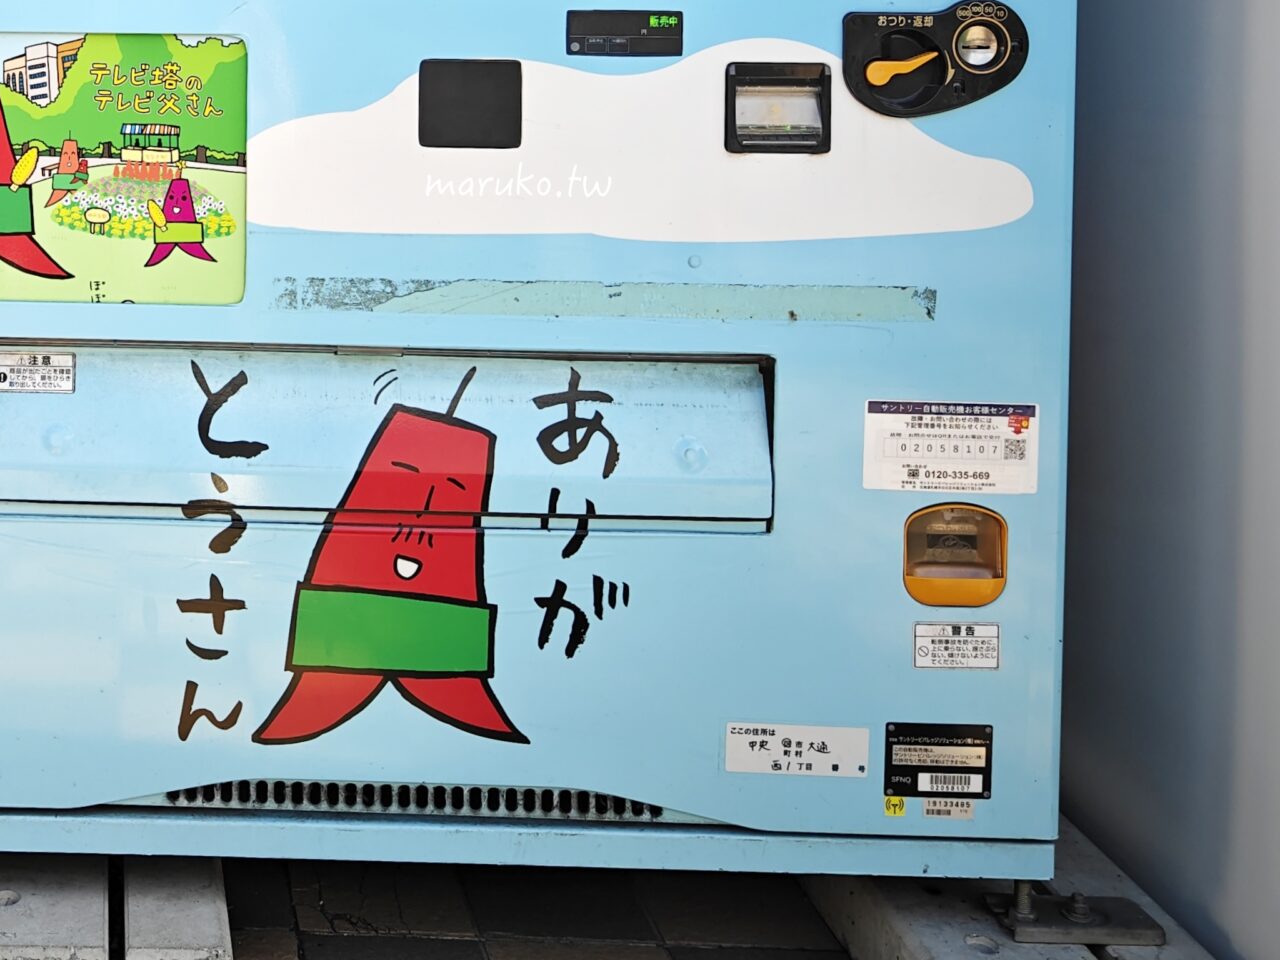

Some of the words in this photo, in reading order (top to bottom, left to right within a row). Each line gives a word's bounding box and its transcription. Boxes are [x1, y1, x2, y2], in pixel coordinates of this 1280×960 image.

[649, 15, 678, 28] 販売中
[877, 15, 934, 28] おつり・返却
[88, 63, 203, 91] テレビ塔の
[93, 92, 224, 117] テレビ父さん
[28, 355, 51, 365] 注意
[881, 403, 1024, 415] サントリー自動販売機お客様センター
[924, 470, 990, 480] 0120-335-669
[531, 366, 630, 659] ありが
[175, 359, 269, 741] とうさん
[952, 625, 976, 636] 警告
[730, 727, 776, 736] ここの住所は
